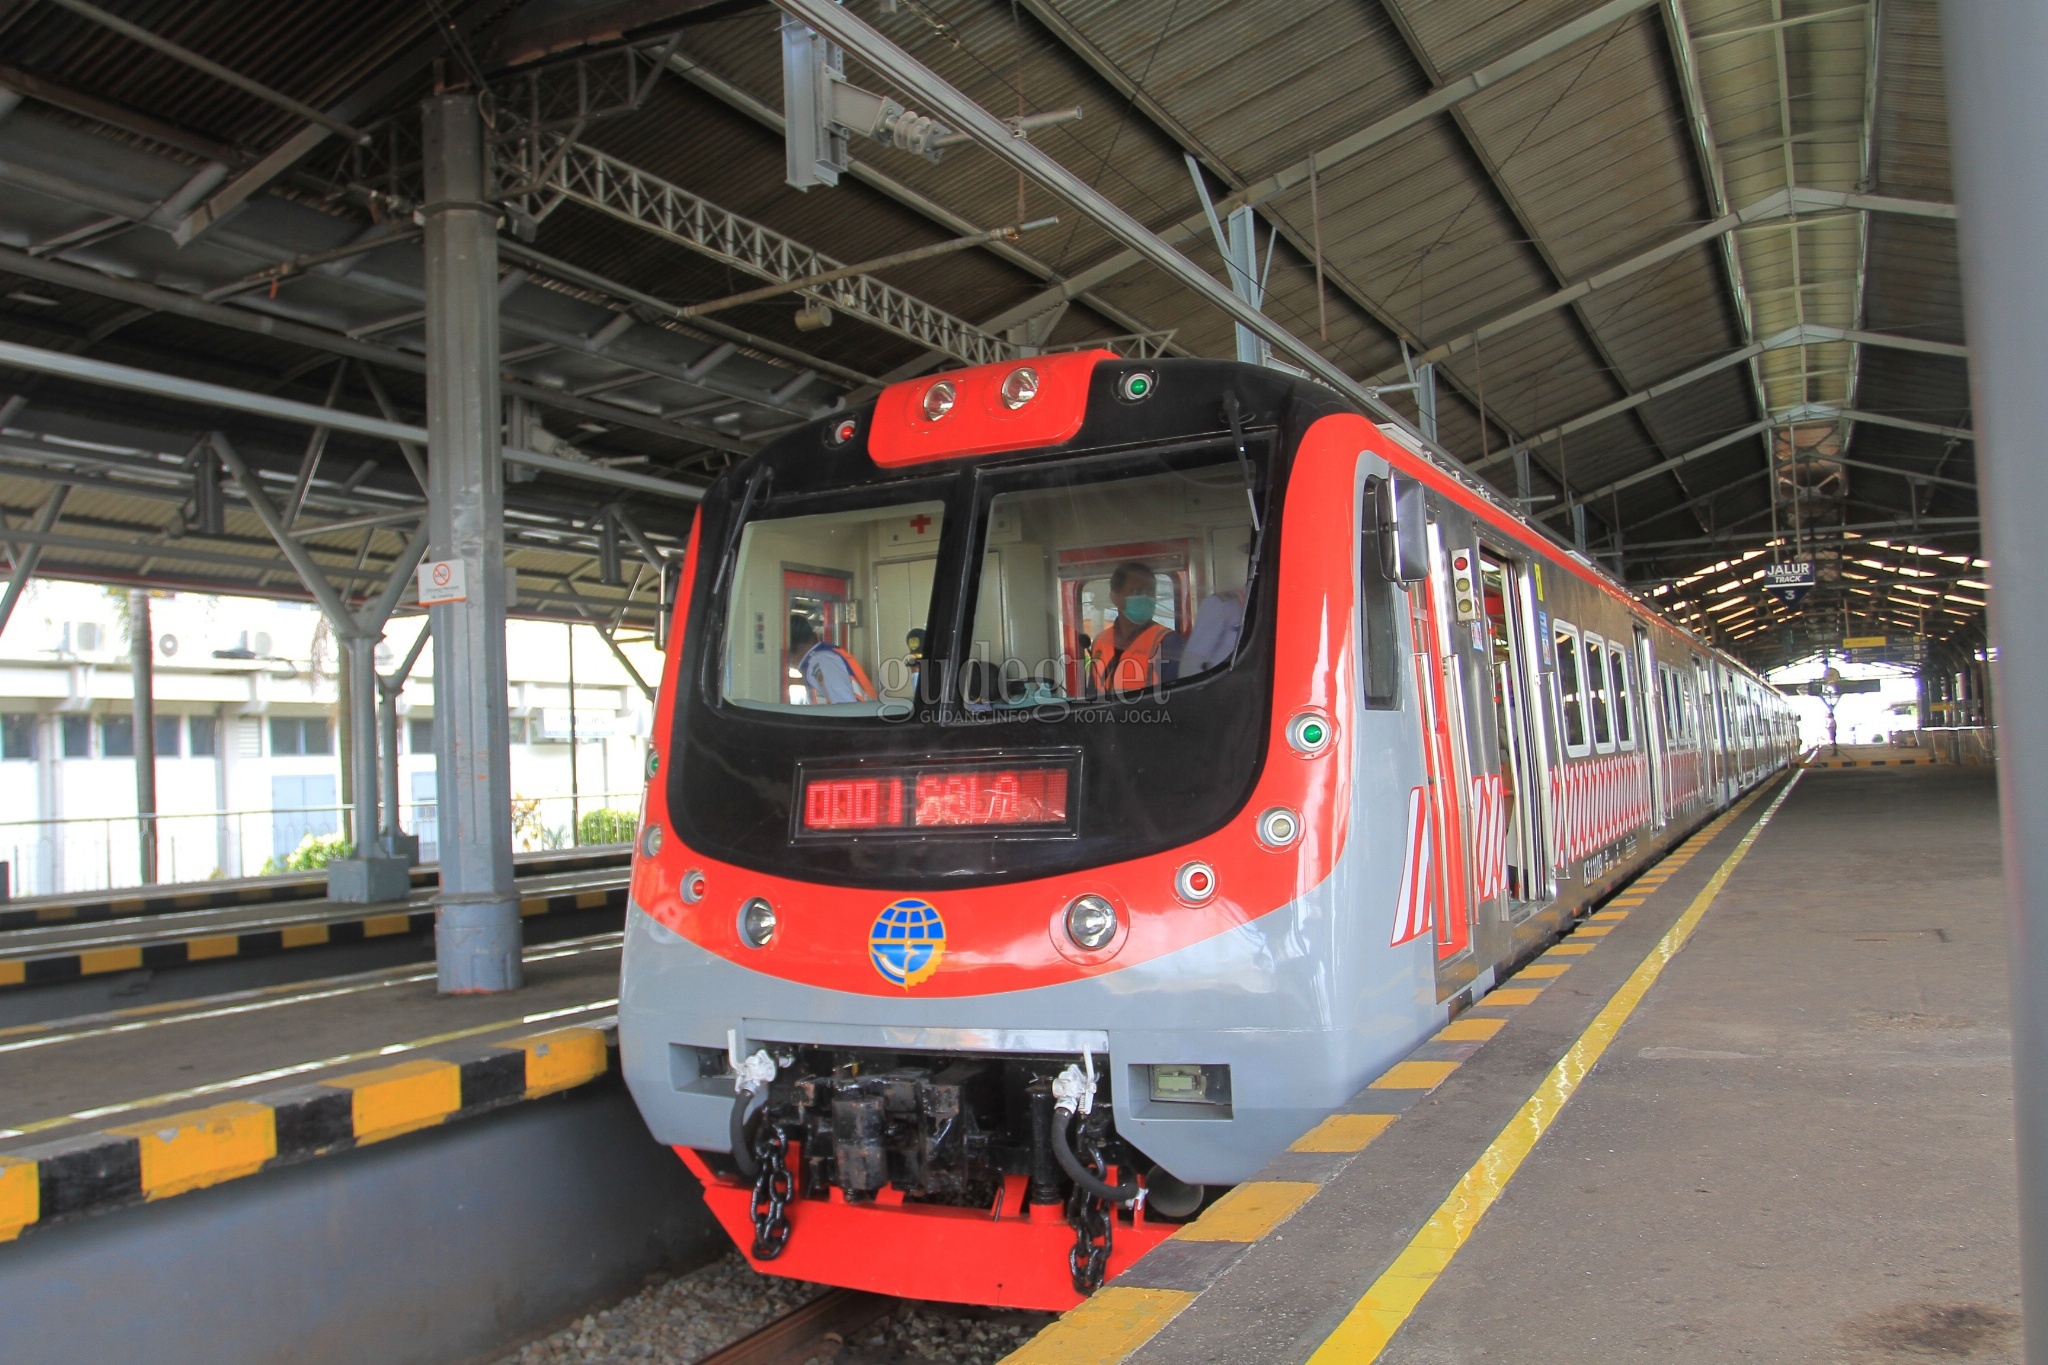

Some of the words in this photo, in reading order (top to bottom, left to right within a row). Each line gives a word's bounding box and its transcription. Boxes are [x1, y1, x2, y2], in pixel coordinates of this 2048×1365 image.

[1767, 563, 1809, 576] JALUR
[1775, 575, 1801, 584] TRACK
[1785, 590, 1795, 600] 3
